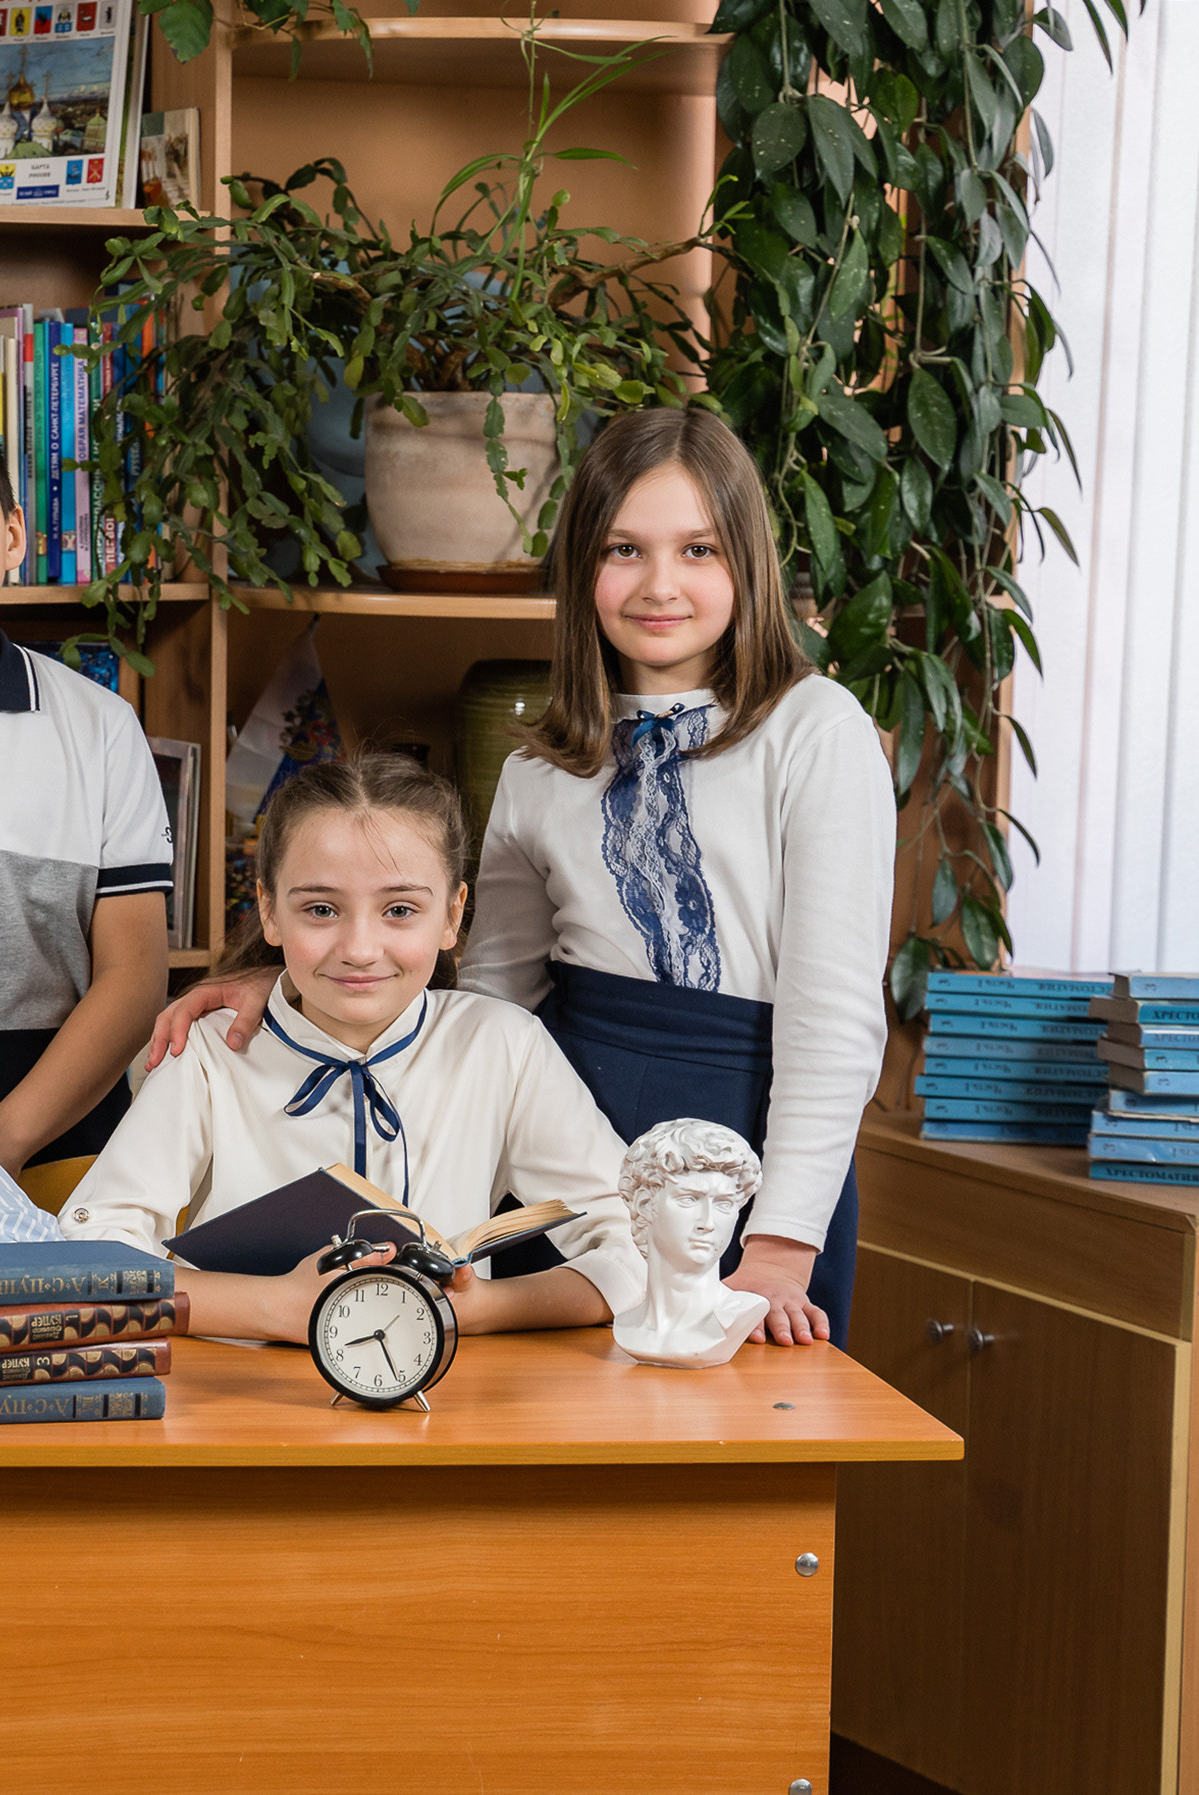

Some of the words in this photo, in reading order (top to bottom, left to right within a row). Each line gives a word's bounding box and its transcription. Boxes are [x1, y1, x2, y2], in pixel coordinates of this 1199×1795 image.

[77, 360, 87, 425] МАТЕМАТИКА
[50, 362, 60, 440] САНКТ-ПЕТЕРБУРГЕ
[50, 442, 59, 450] О
[78, 427, 87, 461] ОБРАЯ
[51, 452, 60, 480] ДЕТЯМ
[354, 1290, 365, 1303] 11
[375, 1283, 389, 1297] 12
[401, 1291, 406, 1304] 1
[338, 1305, 351, 1318] 10
[416, 1309, 425, 1321] 2
[31, 1314, 62, 1327] КУПЕР
[329, 1326, 338, 1339] 9
[423, 1331, 431, 1344] 3
[335, 1349, 344, 1362] 8
[414, 1353, 423, 1366] 4
[1, 1357, 30, 1369] КУПЕР
[36, 1356, 51, 1366] 3
[353, 1366, 361, 1379] 7
[398, 1370, 406, 1383] 5
[374, 1374, 383, 1388] 6
